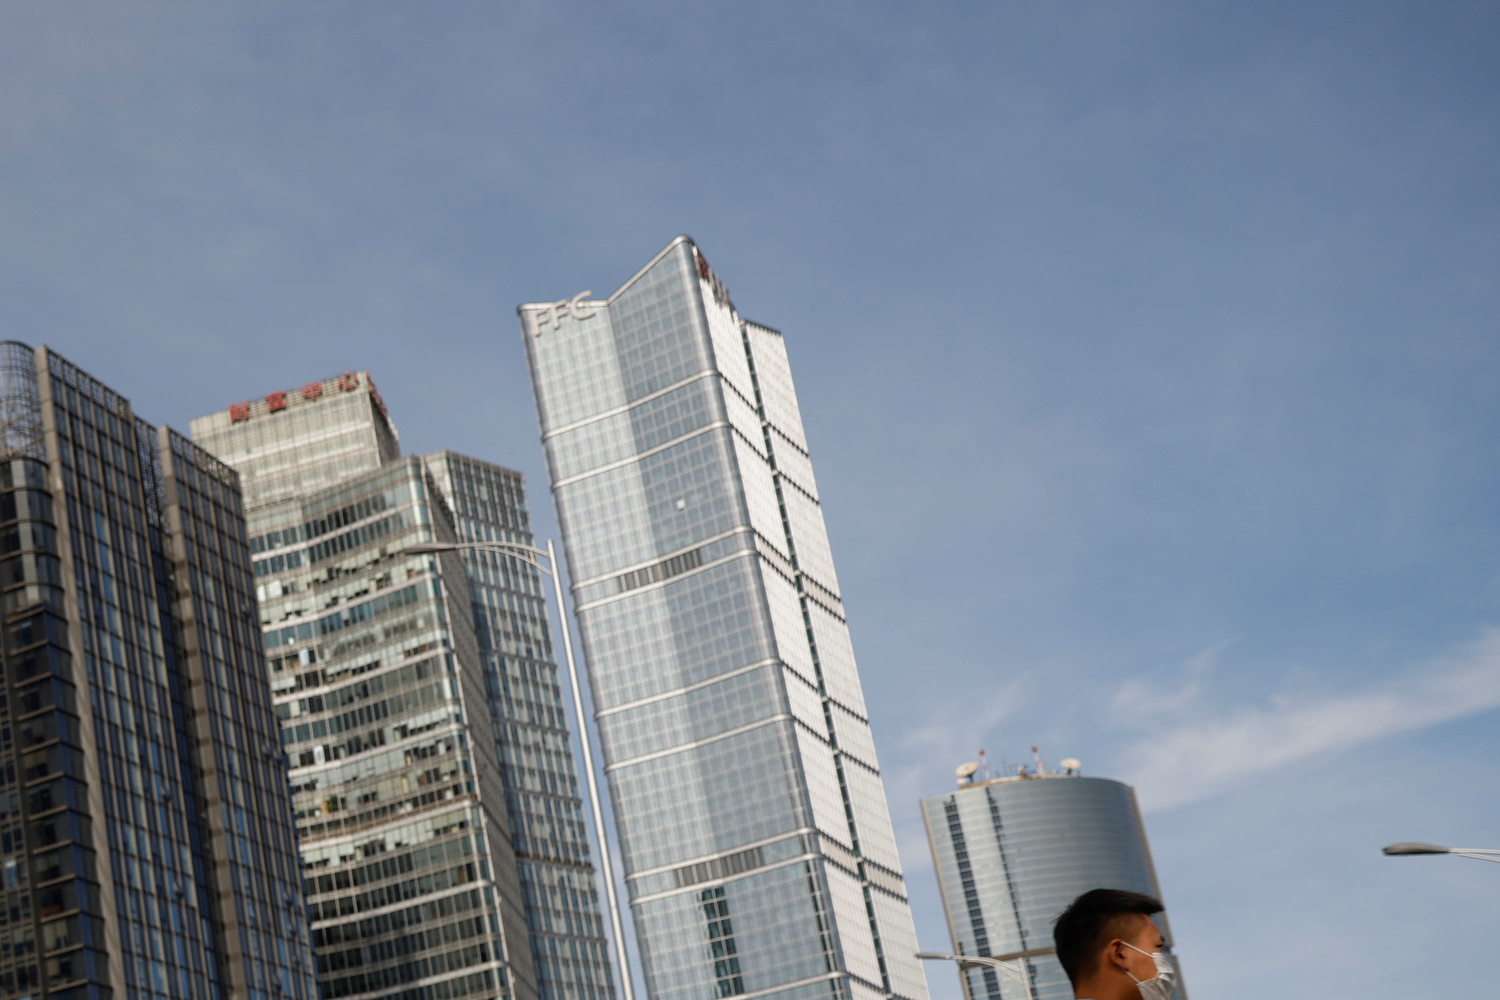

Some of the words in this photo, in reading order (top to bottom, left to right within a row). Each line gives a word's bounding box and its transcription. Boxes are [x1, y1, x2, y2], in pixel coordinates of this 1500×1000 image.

[531, 290, 597, 337] FFC
[229, 371, 359, 423] 财富中心
